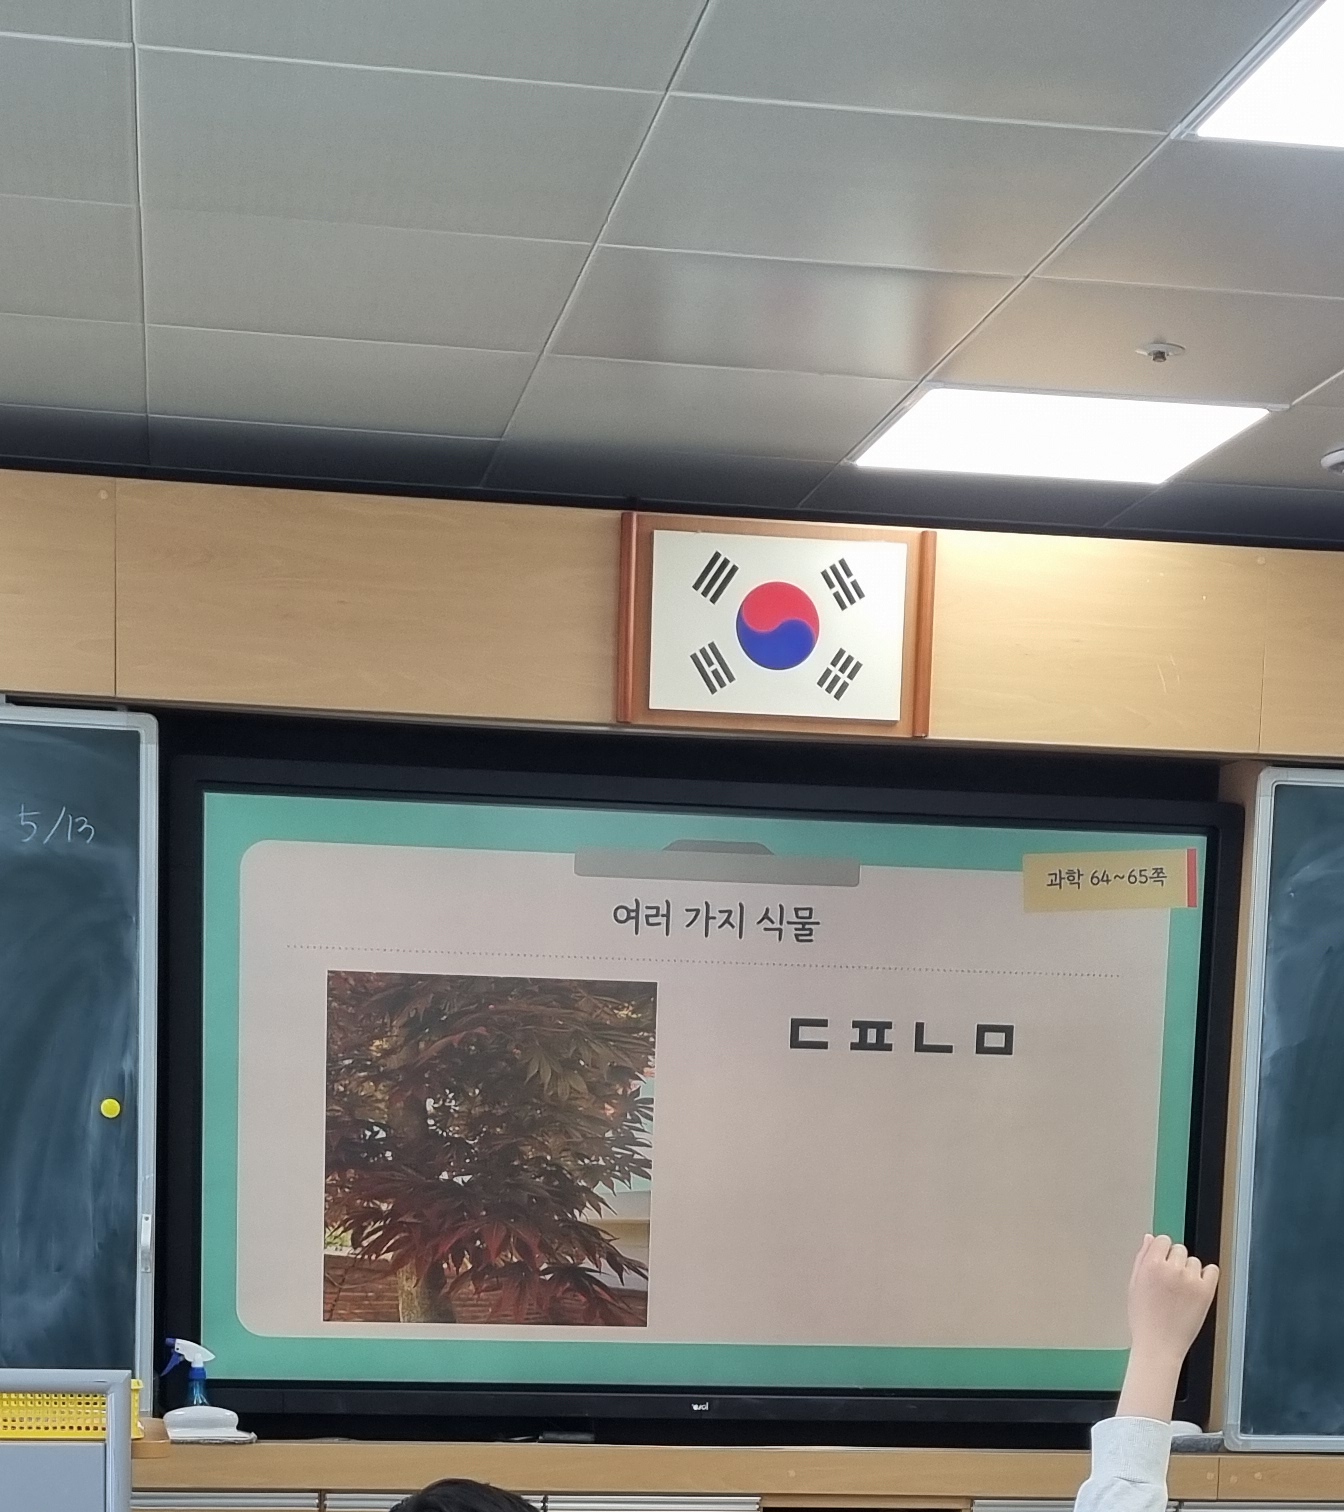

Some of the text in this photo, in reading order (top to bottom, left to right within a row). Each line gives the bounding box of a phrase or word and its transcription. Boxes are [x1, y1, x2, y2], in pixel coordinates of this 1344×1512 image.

[16, 803, 96, 844] 5/13
[1046, 867, 1168, 890] 과학 64~65쪽
[612, 897, 822, 943] 여러 가지 식물
